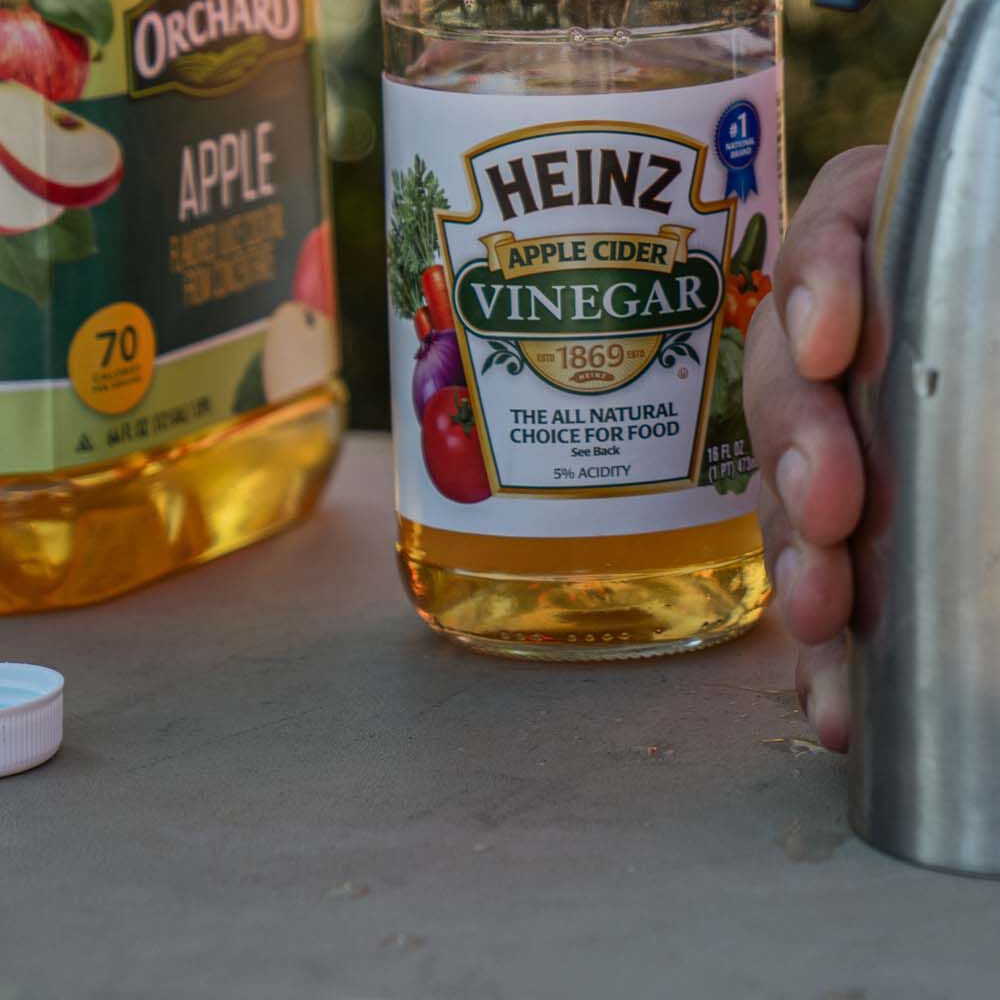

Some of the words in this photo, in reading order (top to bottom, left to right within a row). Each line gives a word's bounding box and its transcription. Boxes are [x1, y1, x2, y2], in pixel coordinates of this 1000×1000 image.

[729, 112, 748, 138] #1
[178, 120, 274, 222] APPLE
[485, 148, 683, 222] HEINZ
[508, 241, 588, 269] APPLE
[592, 240, 669, 265] CIDER
[470, 274, 706, 322] VINEGAR
[95, 324, 138, 368] 70
[555, 343, 625, 370] 1869
[510, 409, 547, 425] THE
[551, 408, 586, 425] ALL
[589, 402, 678, 424] NATURAL
[510, 428, 580, 444] CHOICE
[585, 425, 624, 443] FOR
[627, 421, 680, 440] FOOD
[571, 447, 591, 458] See
[592, 445, 621, 456] Back
[553, 466, 575, 480] 5%
[577, 465, 631, 479] ACIDITY
